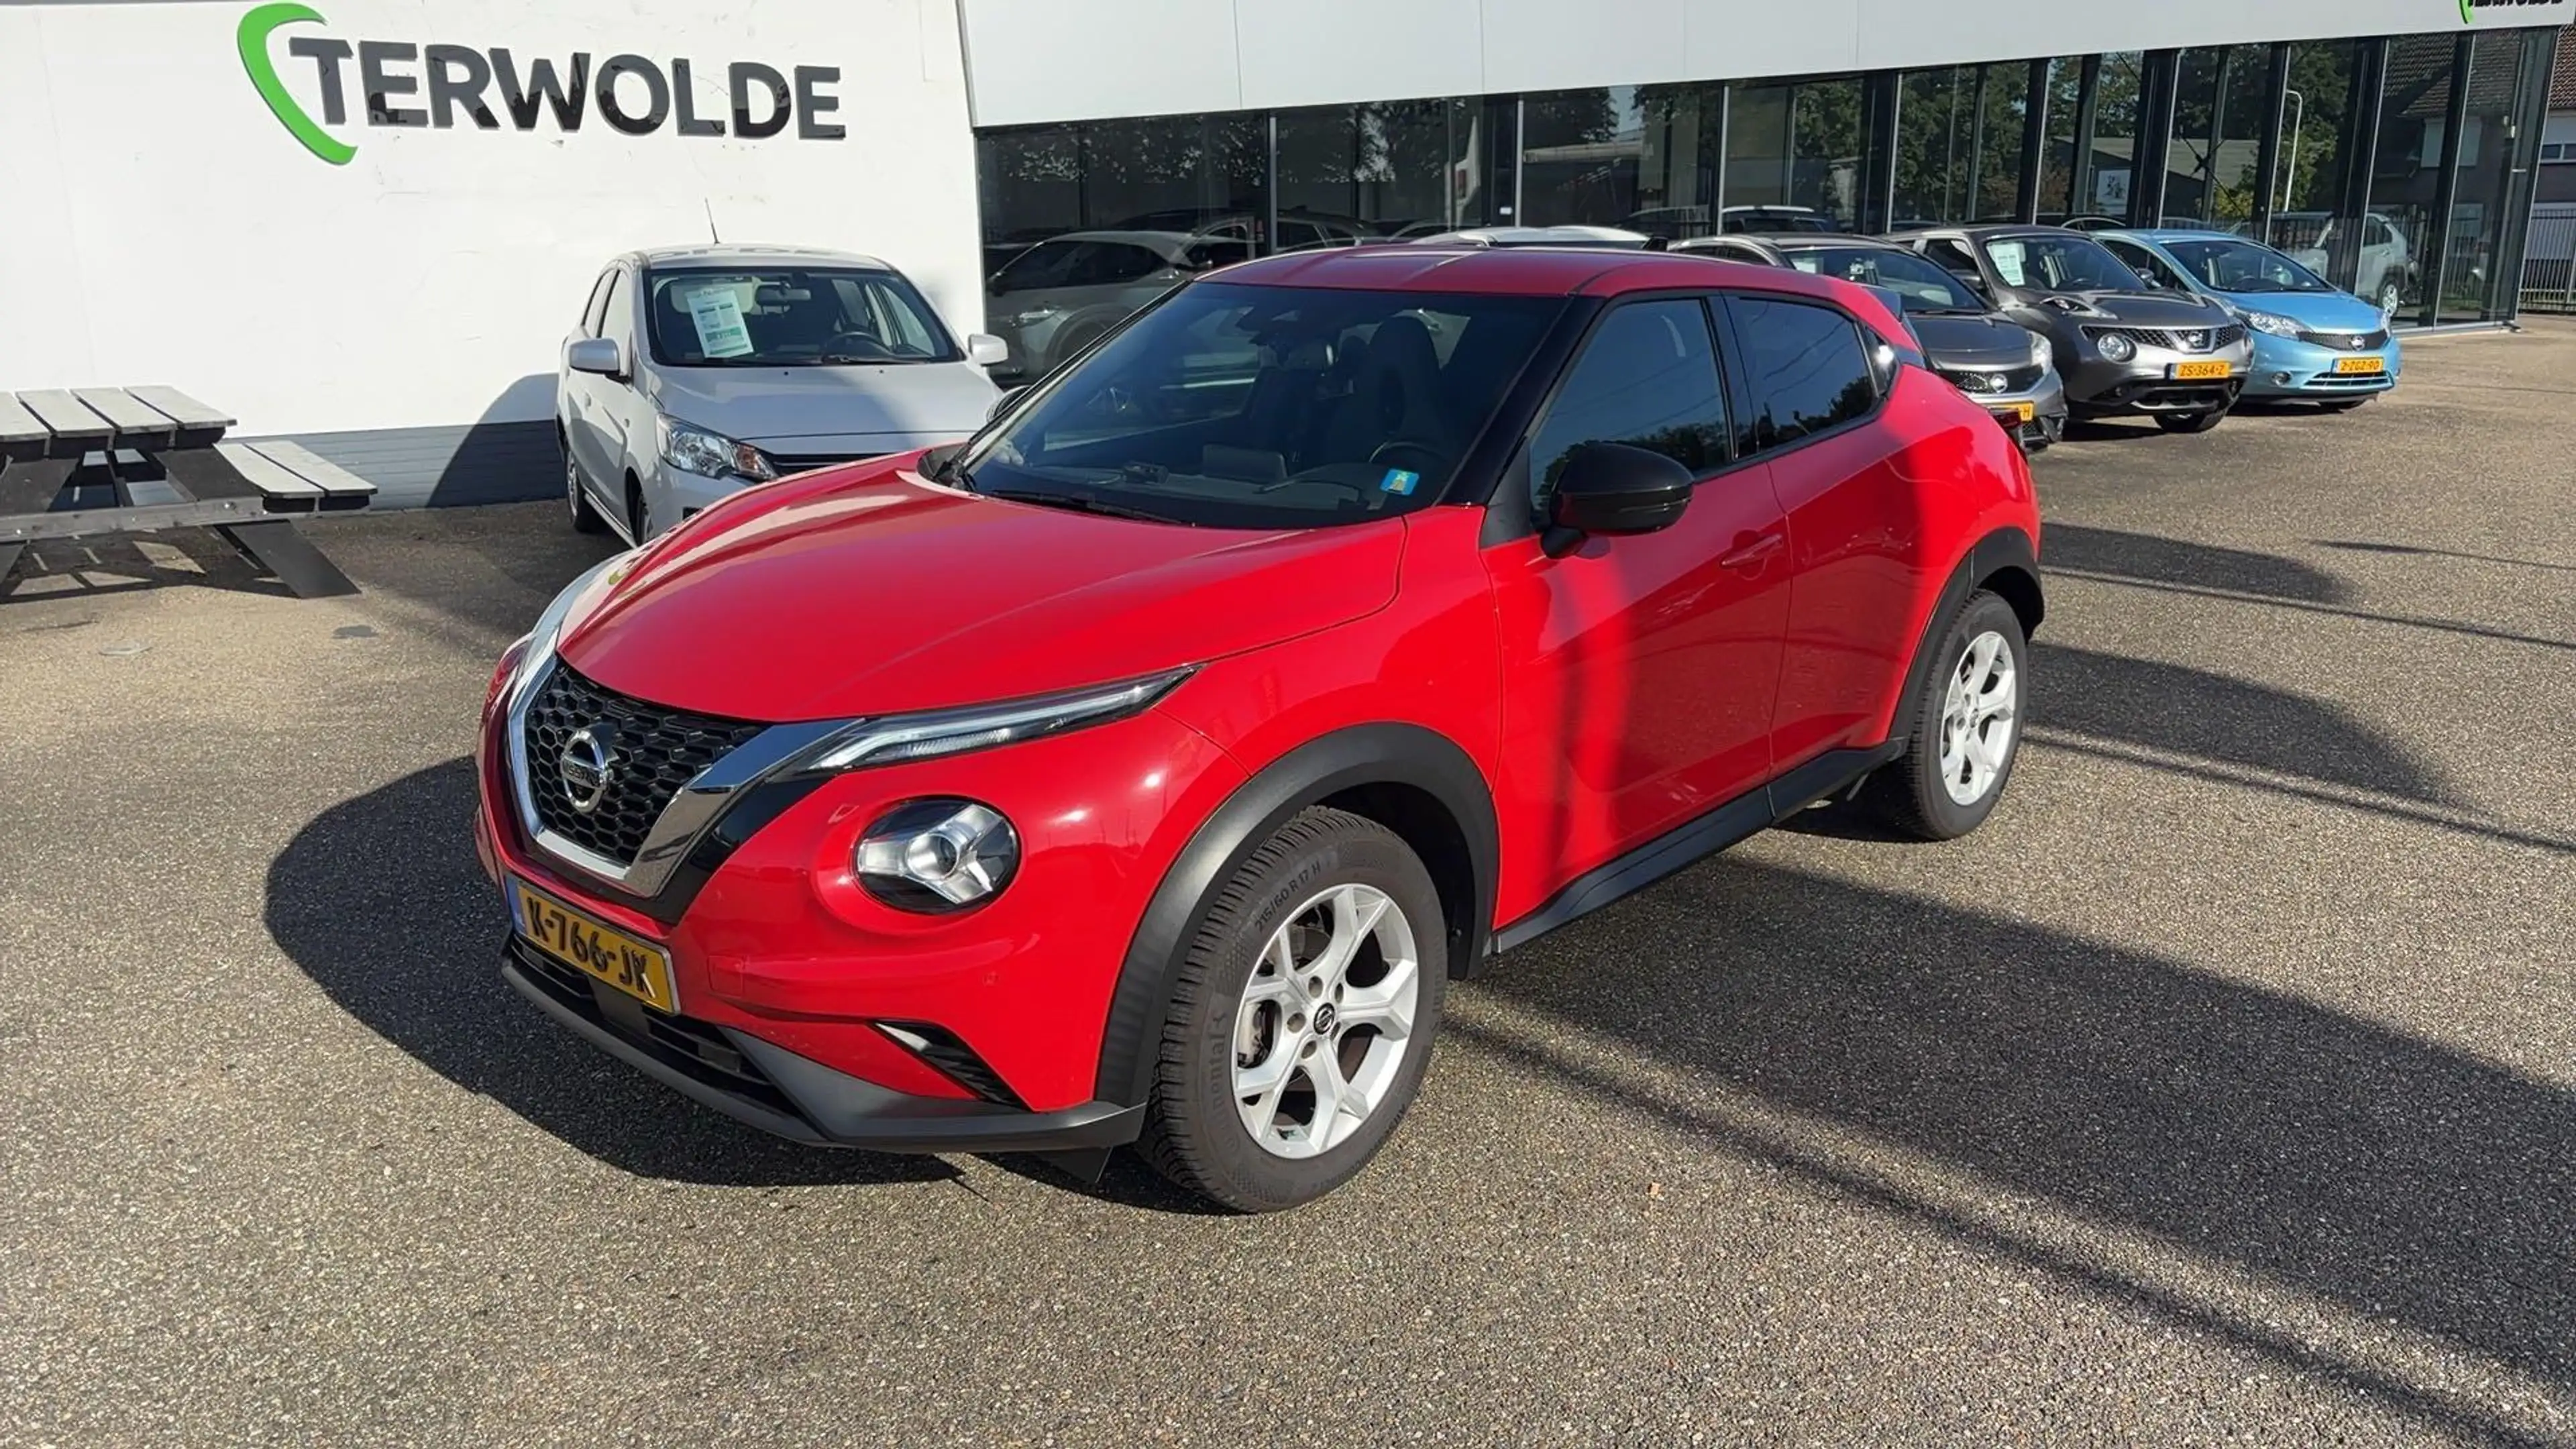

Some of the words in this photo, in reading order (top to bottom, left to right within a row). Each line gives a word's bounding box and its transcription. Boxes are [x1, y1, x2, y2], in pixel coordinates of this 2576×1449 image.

[288, 36, 847, 140] TERWOLDE
[527, 896, 656, 1000] K-766-JK
[1255, 889, 1289, 933] 215/60
[1289, 879, 1299, 893] R
[1298, 869, 1309, 884] 17
[1311, 860, 1321, 876] H
